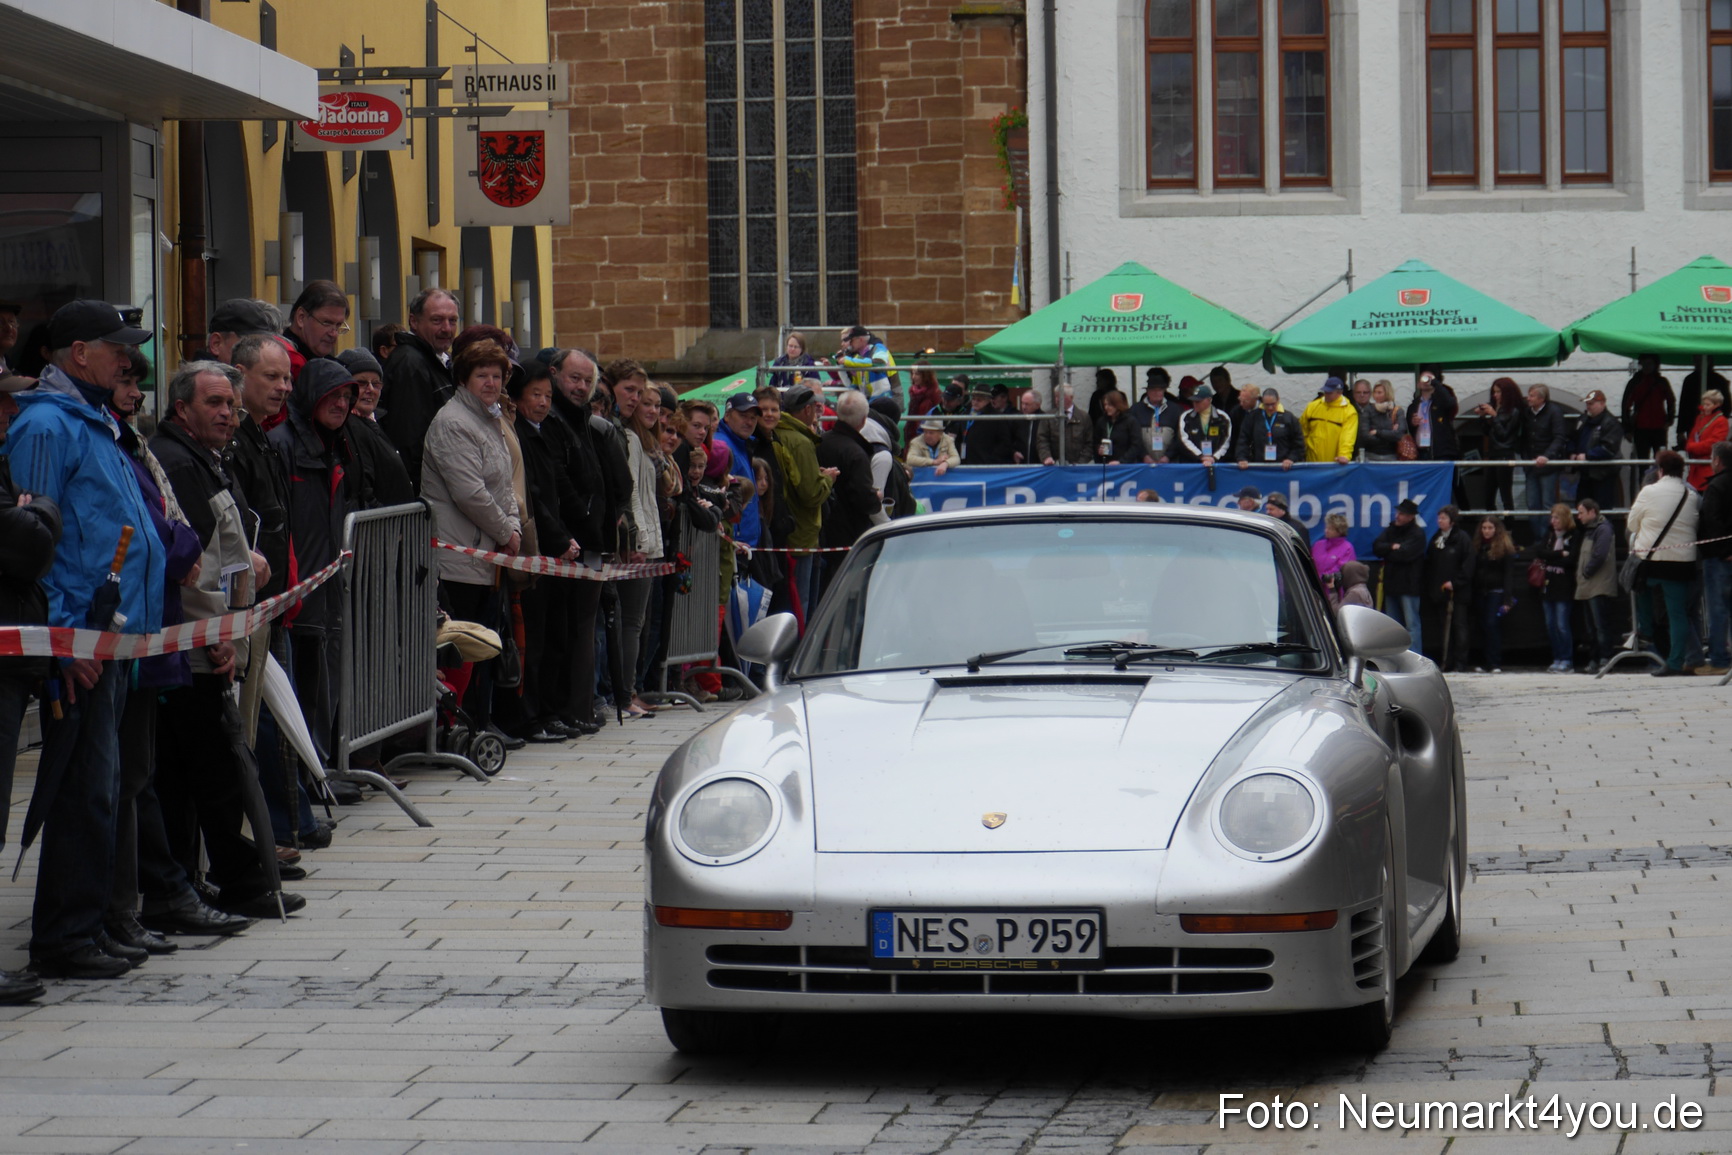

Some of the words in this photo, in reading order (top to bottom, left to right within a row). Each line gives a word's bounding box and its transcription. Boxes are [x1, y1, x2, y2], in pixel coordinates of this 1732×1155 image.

[465, 74, 542, 92] RATHAUS
[547, 74, 557, 91] II
[313, 105, 390, 124] Madonna
[318, 129, 342, 138] Scarpe
[343, 128, 349, 136] &
[351, 128, 385, 136] Accessori
[1080, 313, 1173, 323] Neumarkter
[1369, 309, 1461, 319] Neumarkter
[1061, 320, 1188, 333] Lammsbräu
[1351, 316, 1478, 330] Lammsbräu
[897, 918, 969, 953] NES
[996, 918, 1018, 953] P
[1028, 918, 1097, 953] 959
[879, 939, 888, 949] D
[933, 960, 1038, 969] PORSCHE
